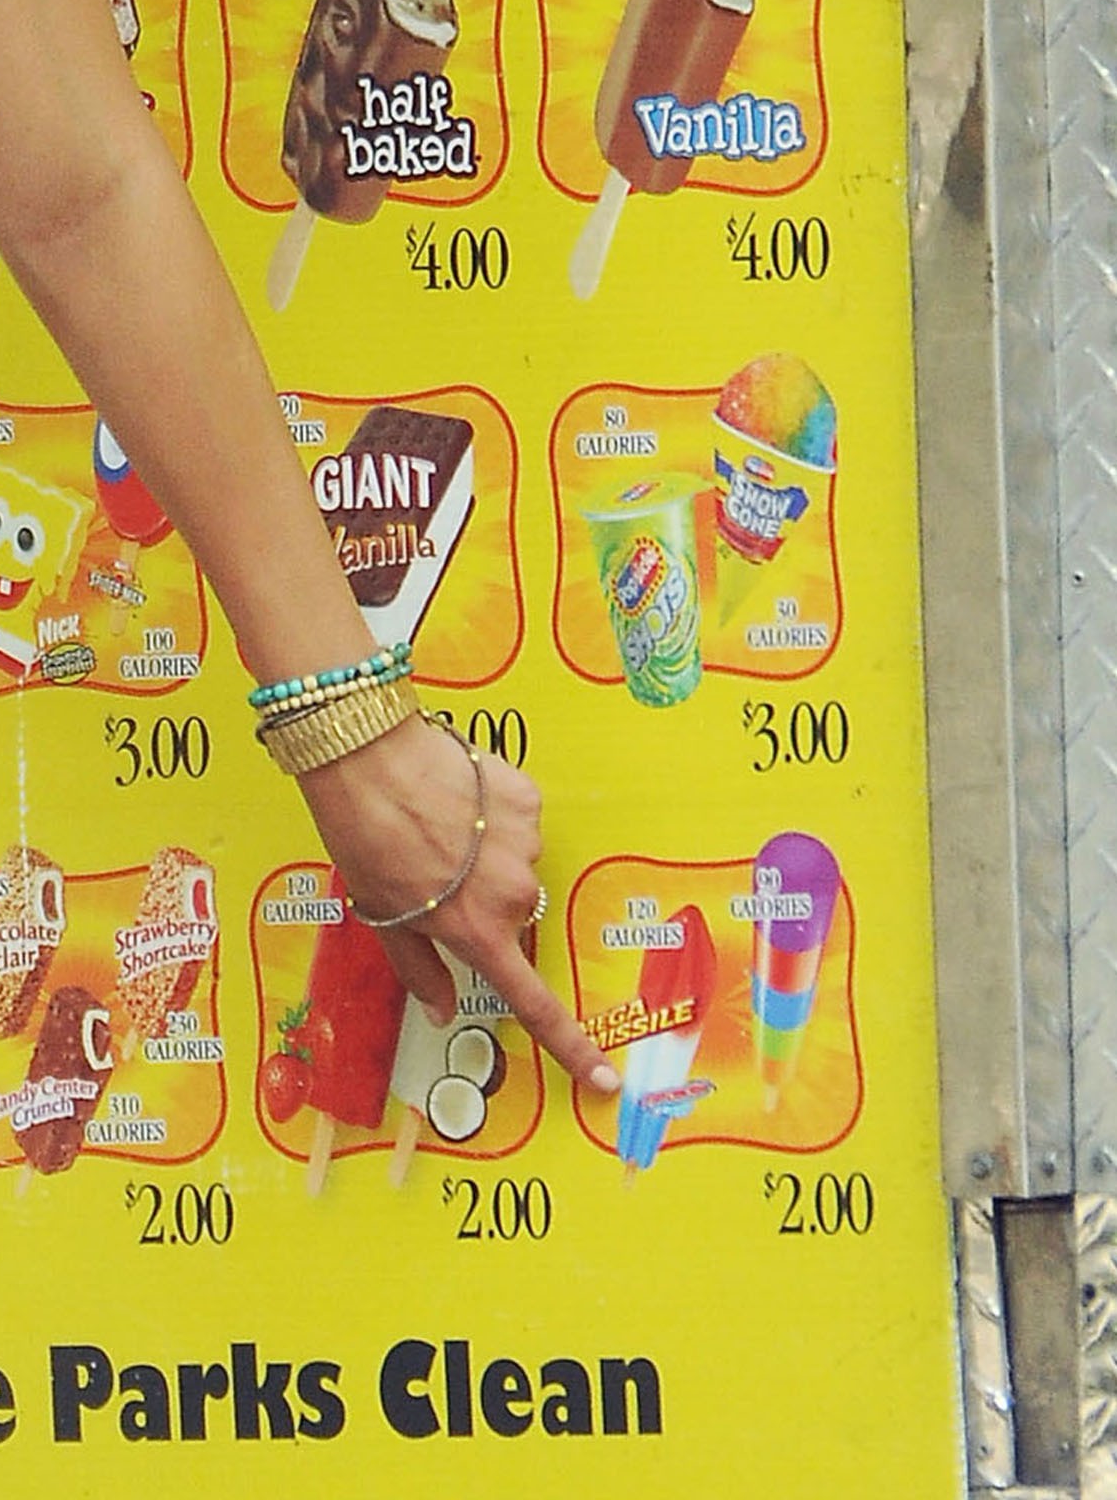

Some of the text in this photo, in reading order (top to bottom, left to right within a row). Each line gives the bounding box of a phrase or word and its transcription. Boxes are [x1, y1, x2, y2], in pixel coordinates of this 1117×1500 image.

[358, 75, 451, 132] half
[635, 97, 805, 158] Vanilla
[341, 122, 473, 176] baked
[405, 220, 510, 291] $4.00
[726, 210, 830, 282] $4.00
[577, 435, 656, 457] CALORIES
[314, 453, 437, 512] GIANT
[730, 473, 792, 520] SNOW
[725, 496, 782, 540] CONE
[145, 631, 173, 652] 100
[747, 627, 827, 647] CALORIES
[121, 656, 199, 678] CALORIES
[105, 714, 211, 787] $3.00
[743, 698, 849, 772] $3.00
[287, 877, 316, 897] 120
[263, 902, 343, 923] CALORIES
[627, 900, 657, 921] 120
[731, 897, 811, 918] CALORIES
[115, 919, 217, 955] Strawberry
[603, 926, 684, 947] CALORIES
[122, 941, 208, 979] Shortcake
[145, 1040, 224, 1062] CALORIES
[41, 1077, 96, 1098] Center
[12, 1097, 72, 1129] Crunch
[109, 1096, 140, 1119] 310
[86, 1122, 166, 1143] CALORIES
[125, 1180, 234, 1245] $2.00
[442, 1175, 552, 1240] $2.00
[765, 1171, 874, 1236] $2.00
[49, 1342, 346, 1444] Parks
[379, 1339, 664, 1439] Clean
